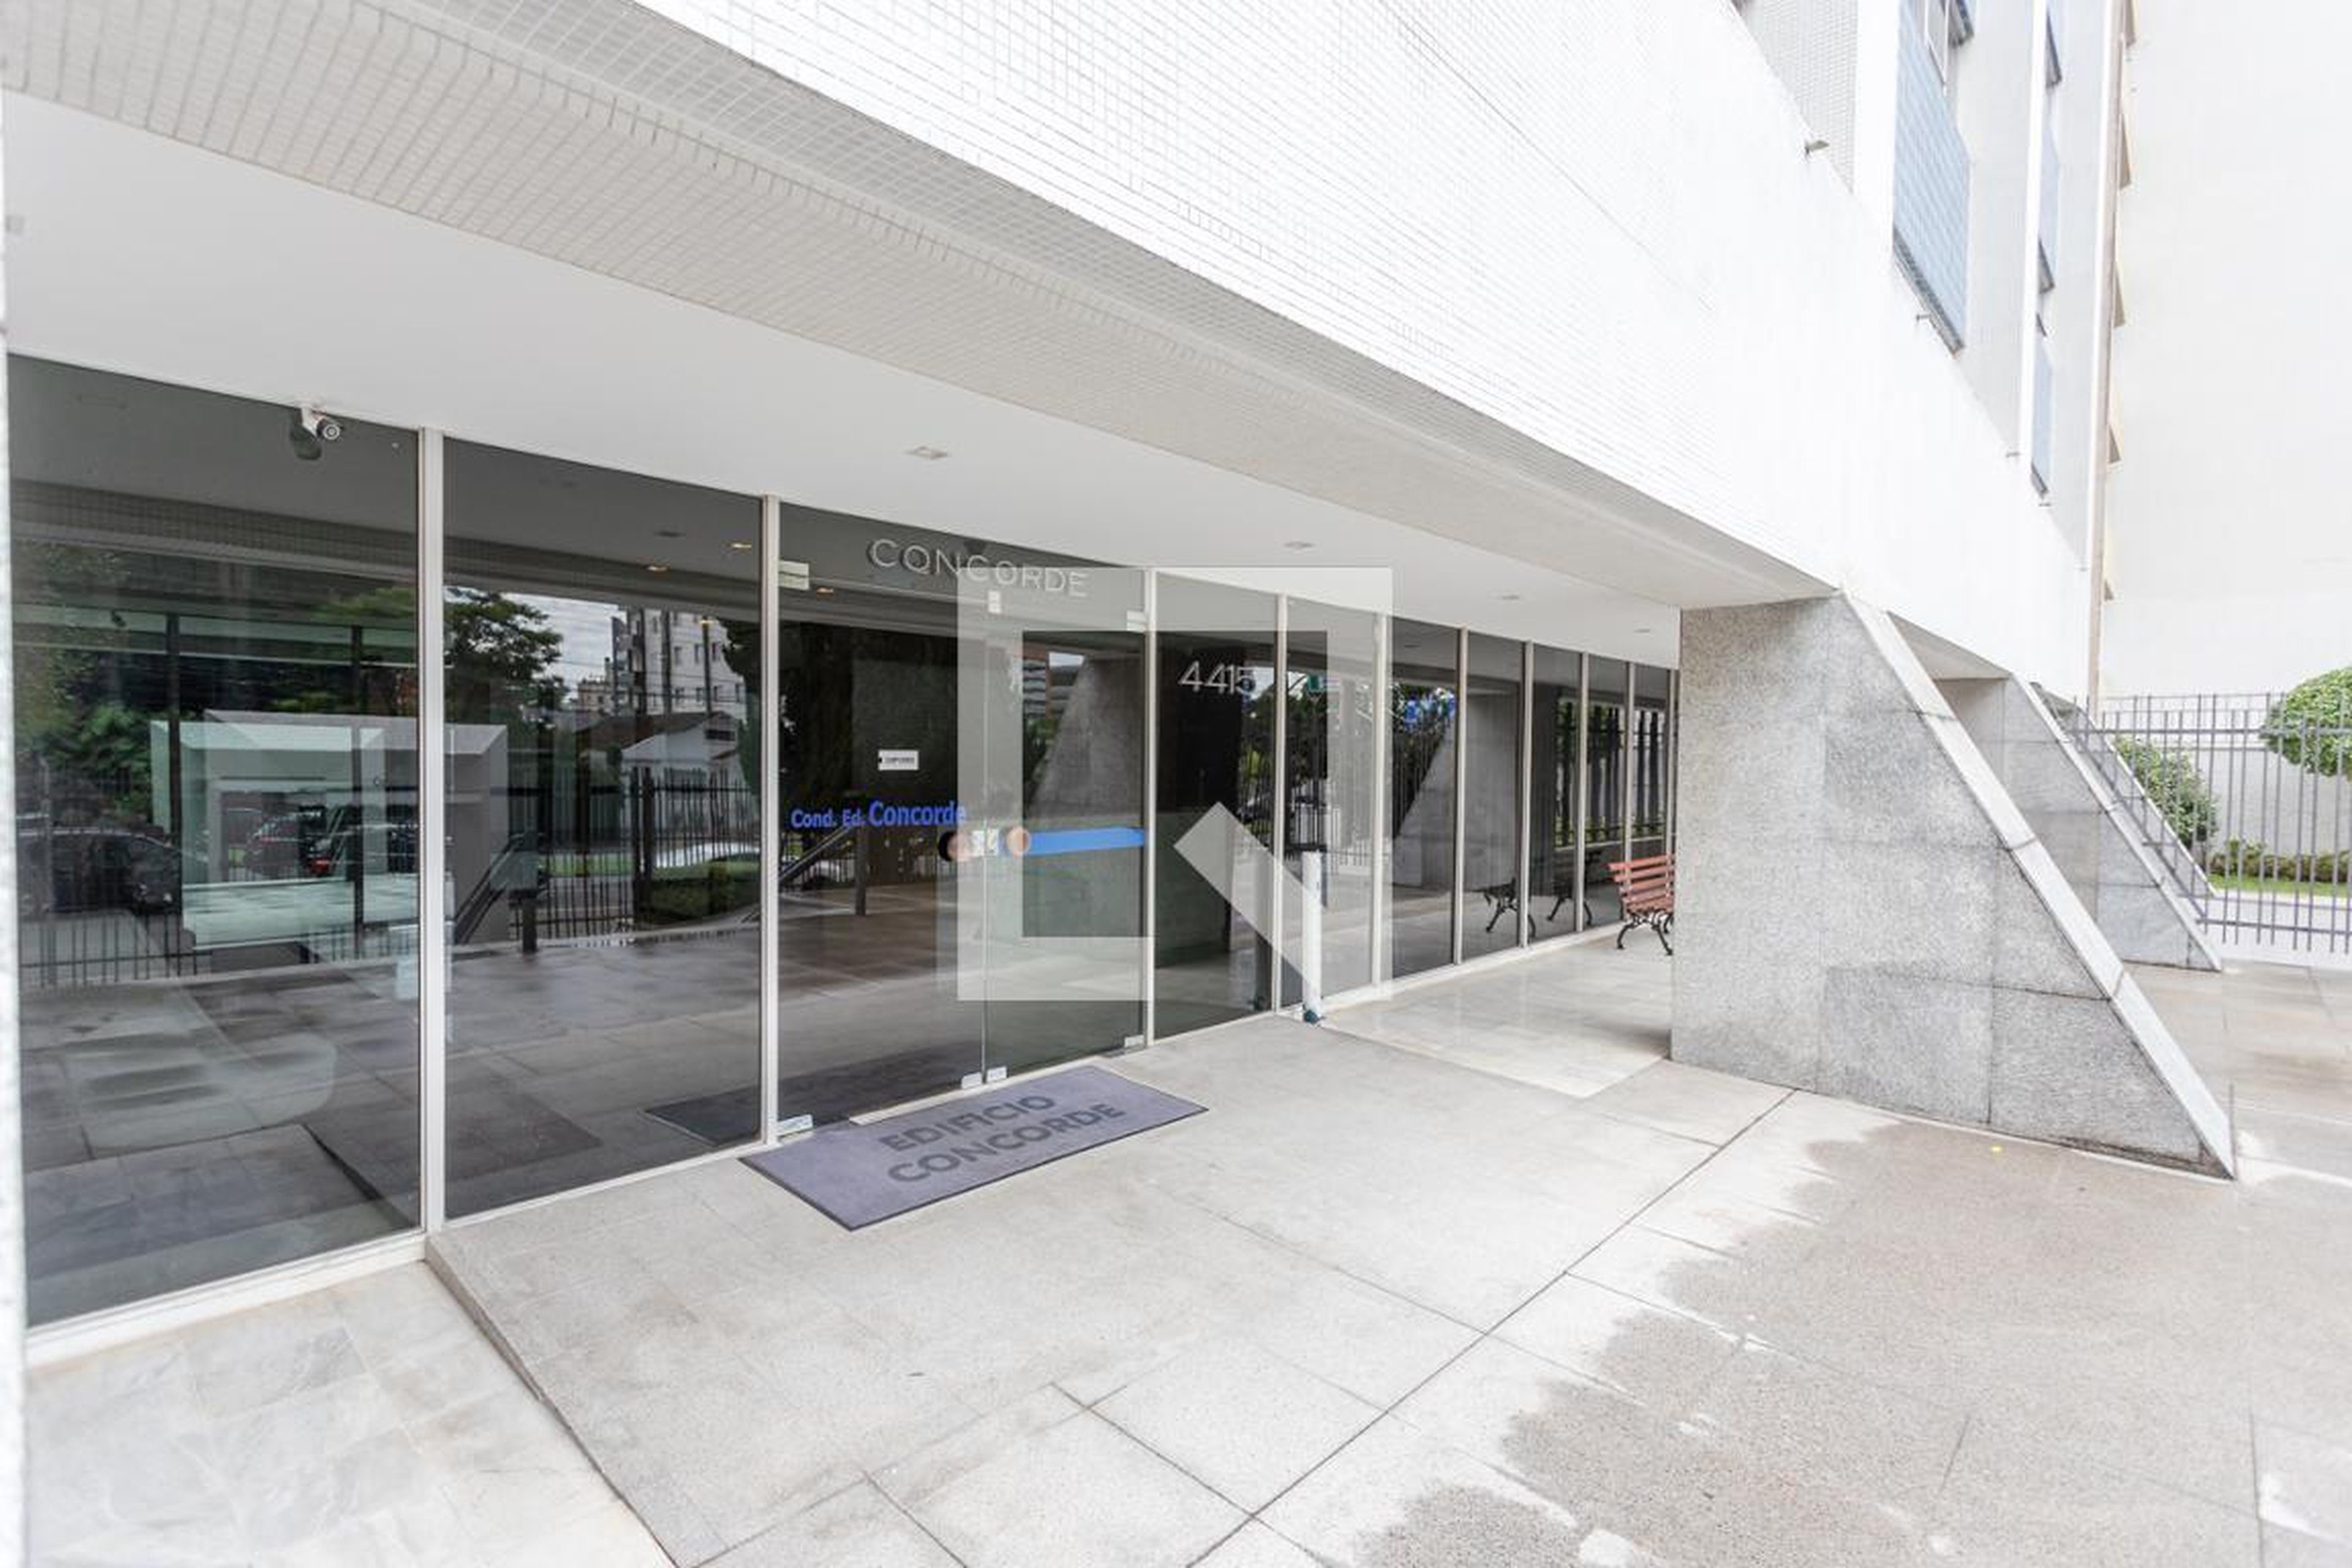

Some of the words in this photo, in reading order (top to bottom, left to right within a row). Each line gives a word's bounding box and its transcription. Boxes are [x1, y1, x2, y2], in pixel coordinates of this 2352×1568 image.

[870, 538, 1088, 598] CONCORDE
[1178, 659, 1254, 695] 4415
[791, 809, 837, 828] Cond.
[842, 808, 866, 827] Ed.
[869, 800, 967, 826] Concorde
[878, 1095, 1057, 1152] EDIFICIO
[888, 1103, 1127, 1183] CONCORDE
